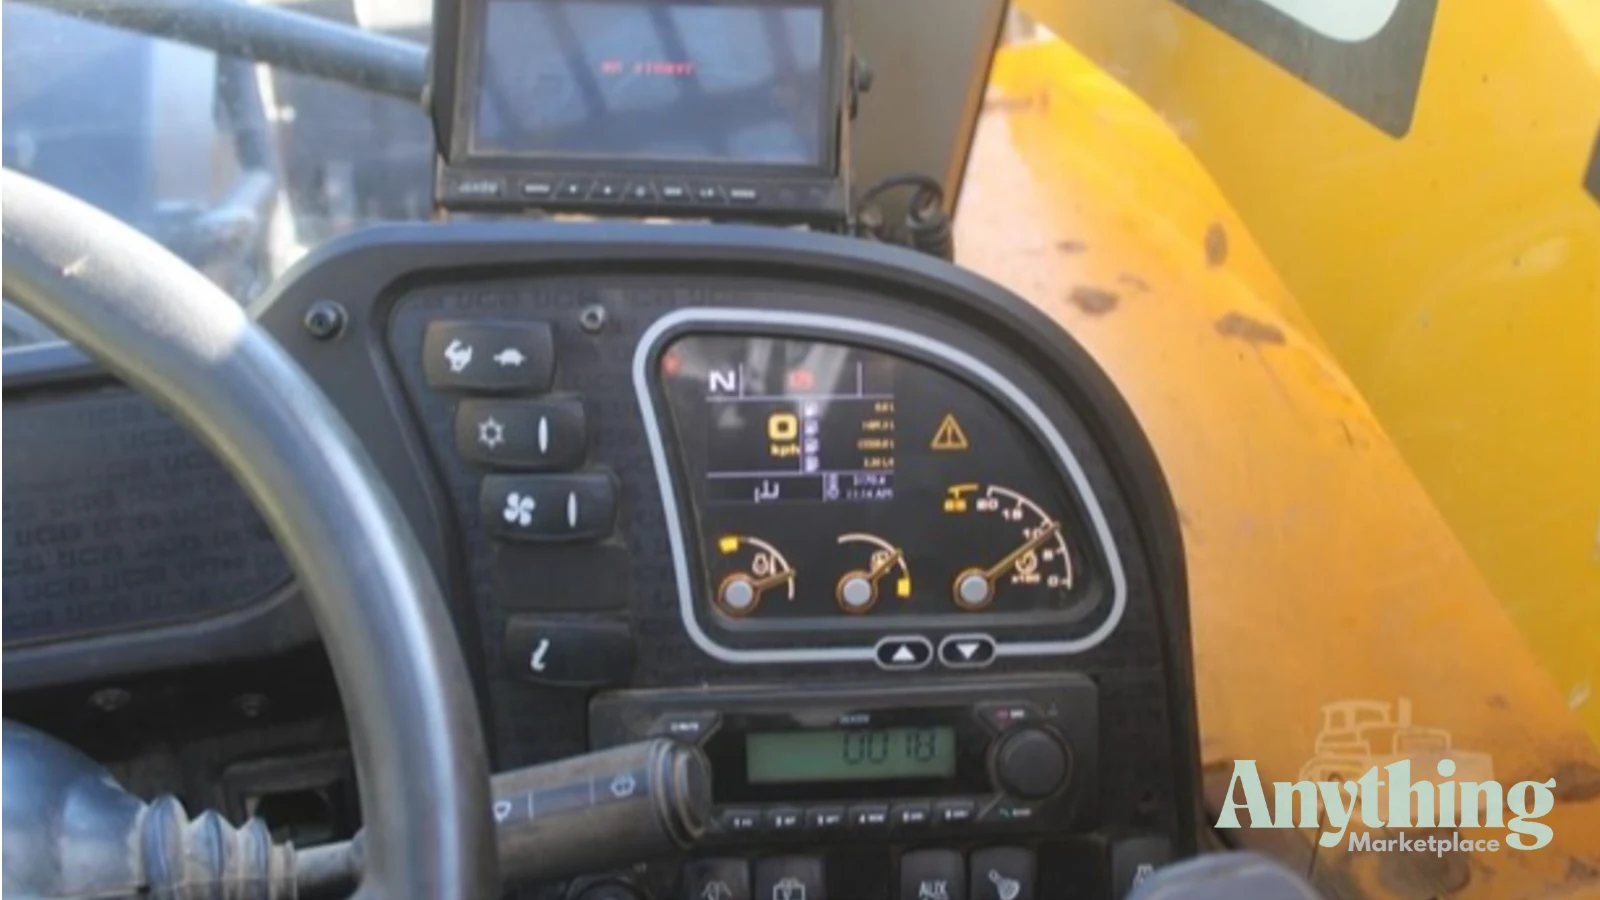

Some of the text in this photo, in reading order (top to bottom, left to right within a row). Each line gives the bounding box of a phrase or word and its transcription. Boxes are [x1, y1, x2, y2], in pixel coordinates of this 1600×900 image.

[709, 369, 736, 392] N
[768, 413, 798, 441] 0
[770, 443, 801, 458] kph
[918, 880, 948, 898] AUX
